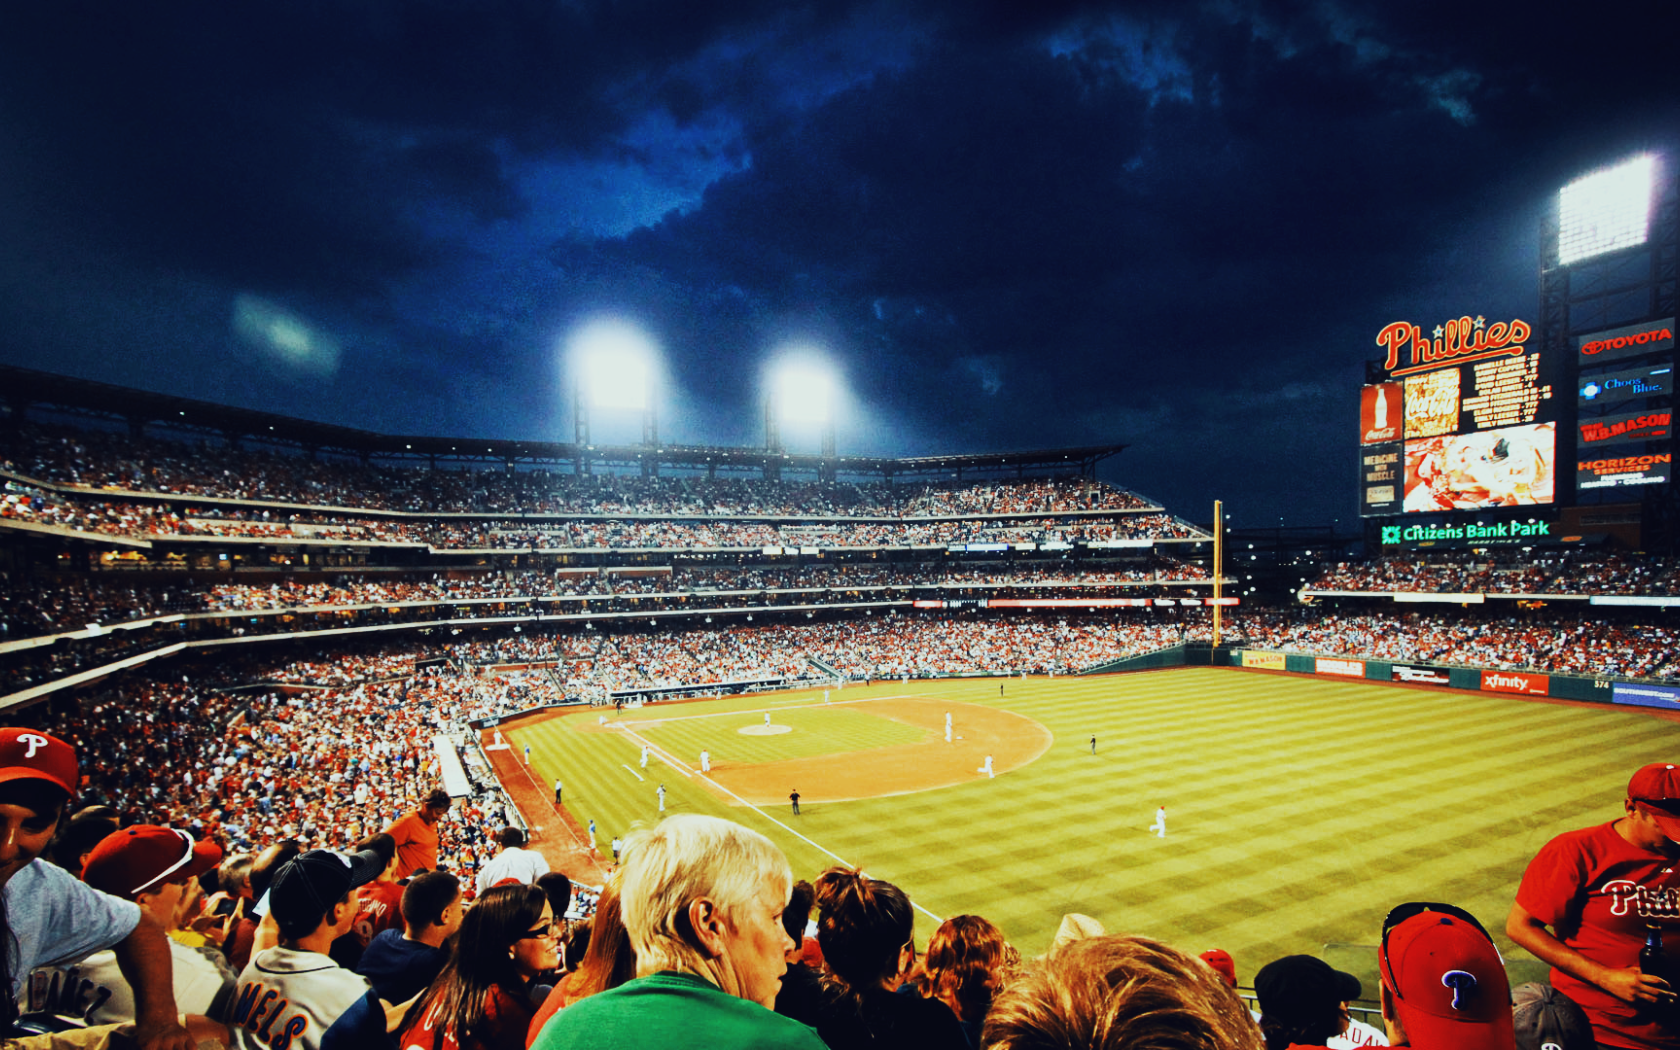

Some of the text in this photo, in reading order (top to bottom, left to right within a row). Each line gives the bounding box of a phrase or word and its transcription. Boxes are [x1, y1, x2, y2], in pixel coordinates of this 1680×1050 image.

[1376, 315, 1531, 370] Phillies
[1604, 328, 1672, 350] TOYOTA
[1577, 453, 1672, 471] HORIZON
[1593, 464, 1651, 475] SERVICES
[1403, 520, 1550, 540] Citizens Bank Park
[1485, 674, 1528, 690] xfinity
[16, 733, 49, 758] P
[1441, 969, 1478, 1011] P
